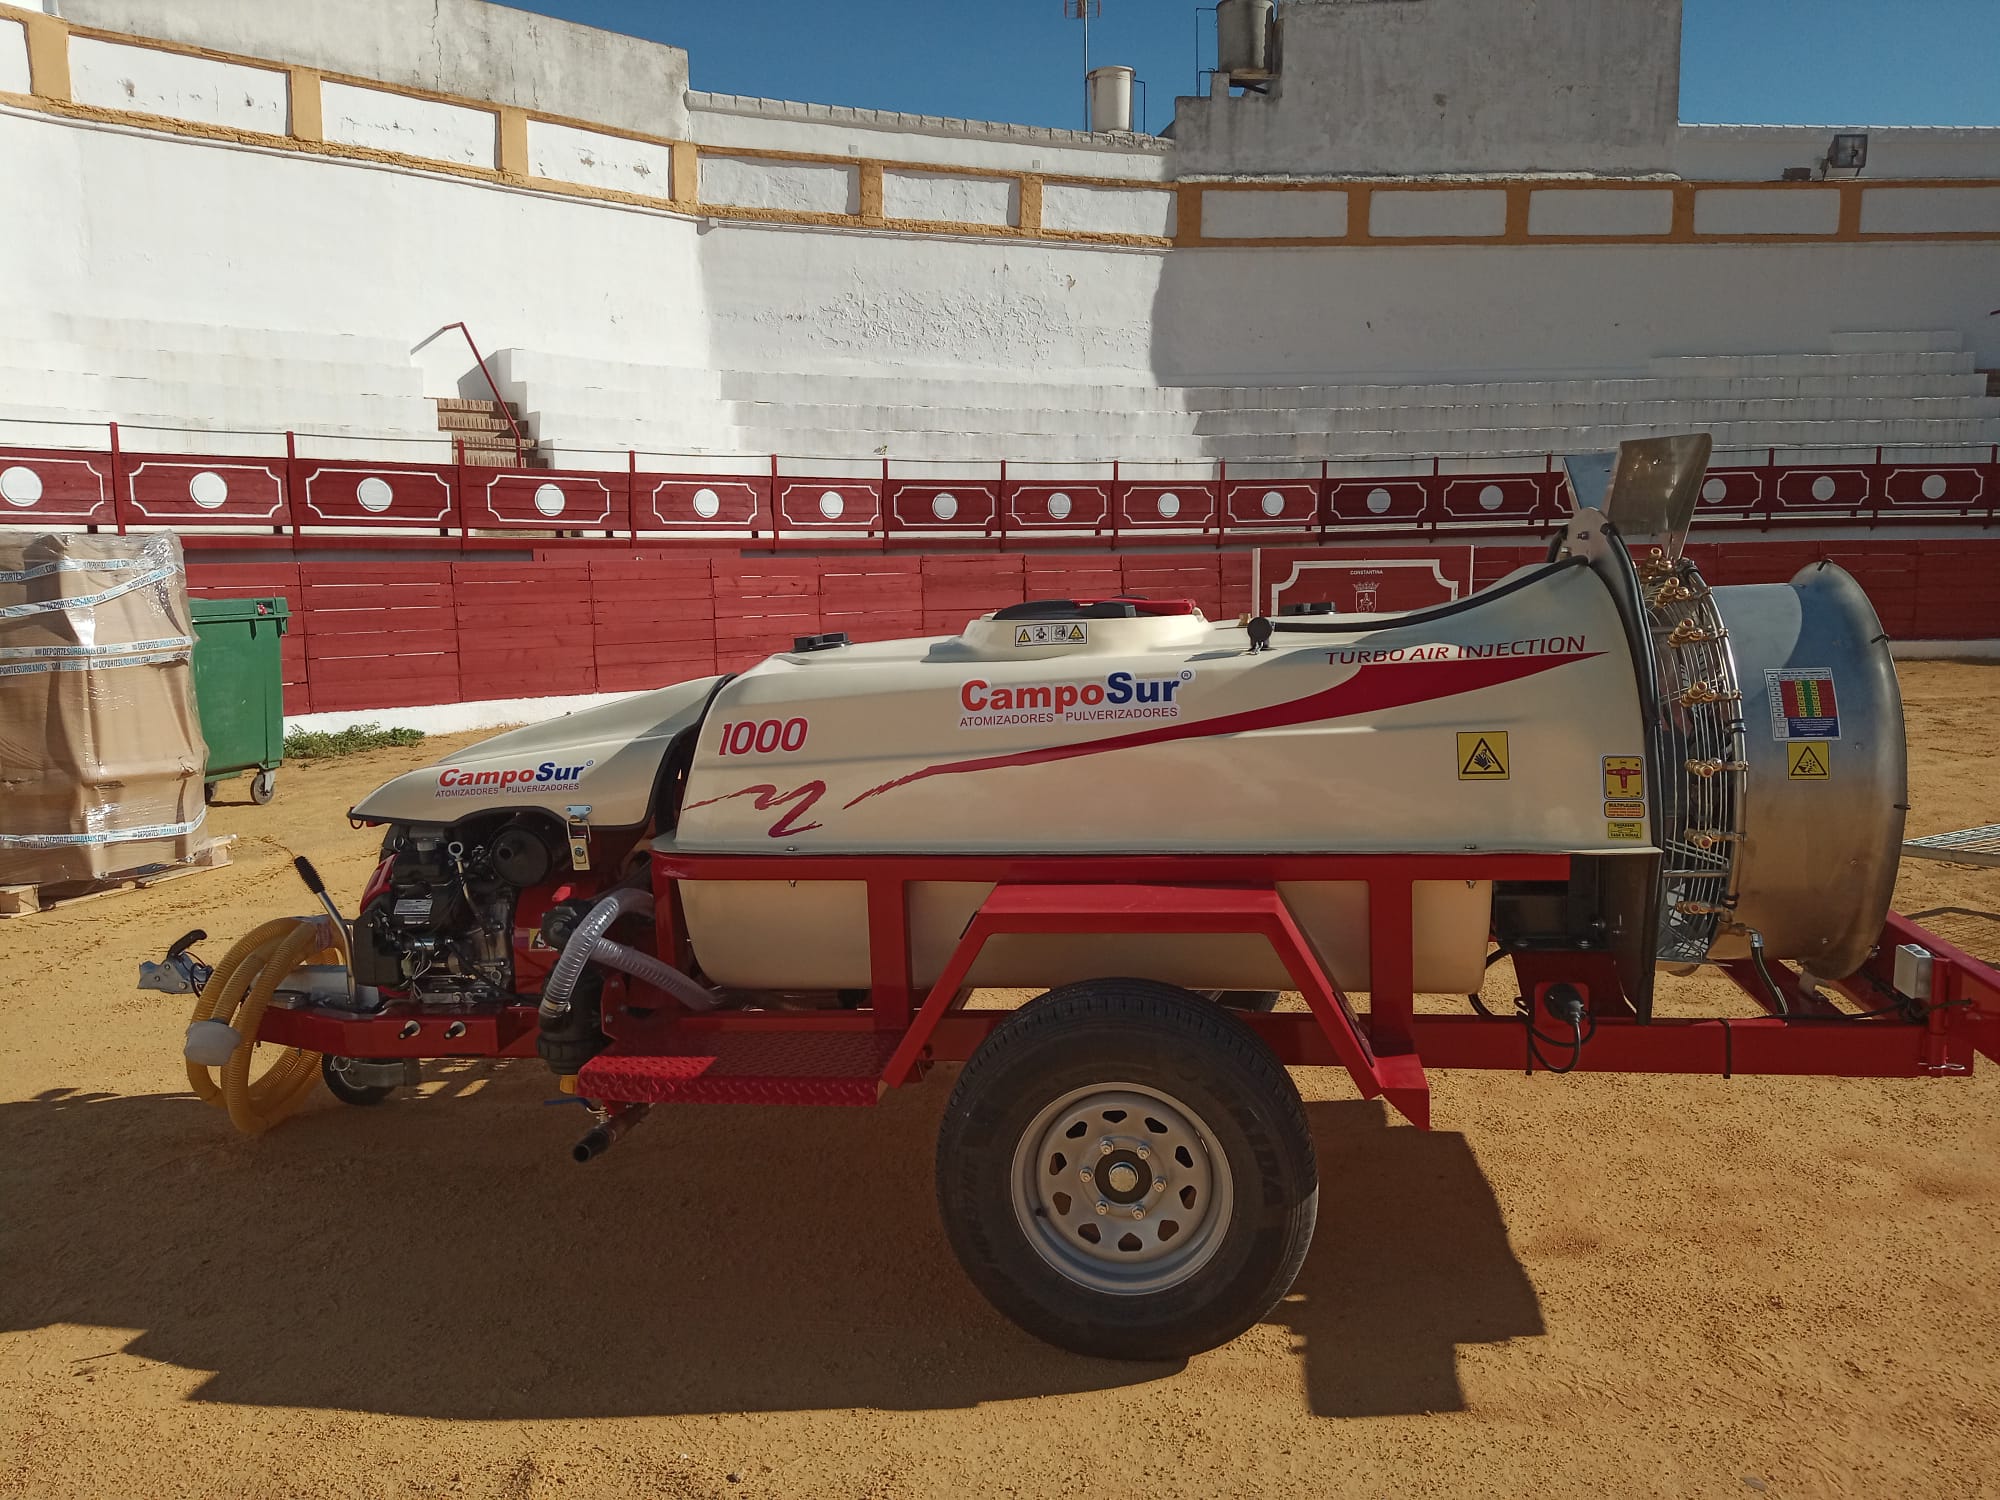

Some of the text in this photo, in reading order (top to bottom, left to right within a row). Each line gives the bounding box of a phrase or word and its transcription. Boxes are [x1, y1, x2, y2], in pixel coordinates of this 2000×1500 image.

[1325, 635, 1585, 665] TURBO AIR INJECTION
[960, 707, 1178, 727] ATOMIZADORES PULVERIZADORES
[718, 717, 808, 756] 1000
[435, 783, 580, 798] ATOMIZADORES PULVERIZADORES
